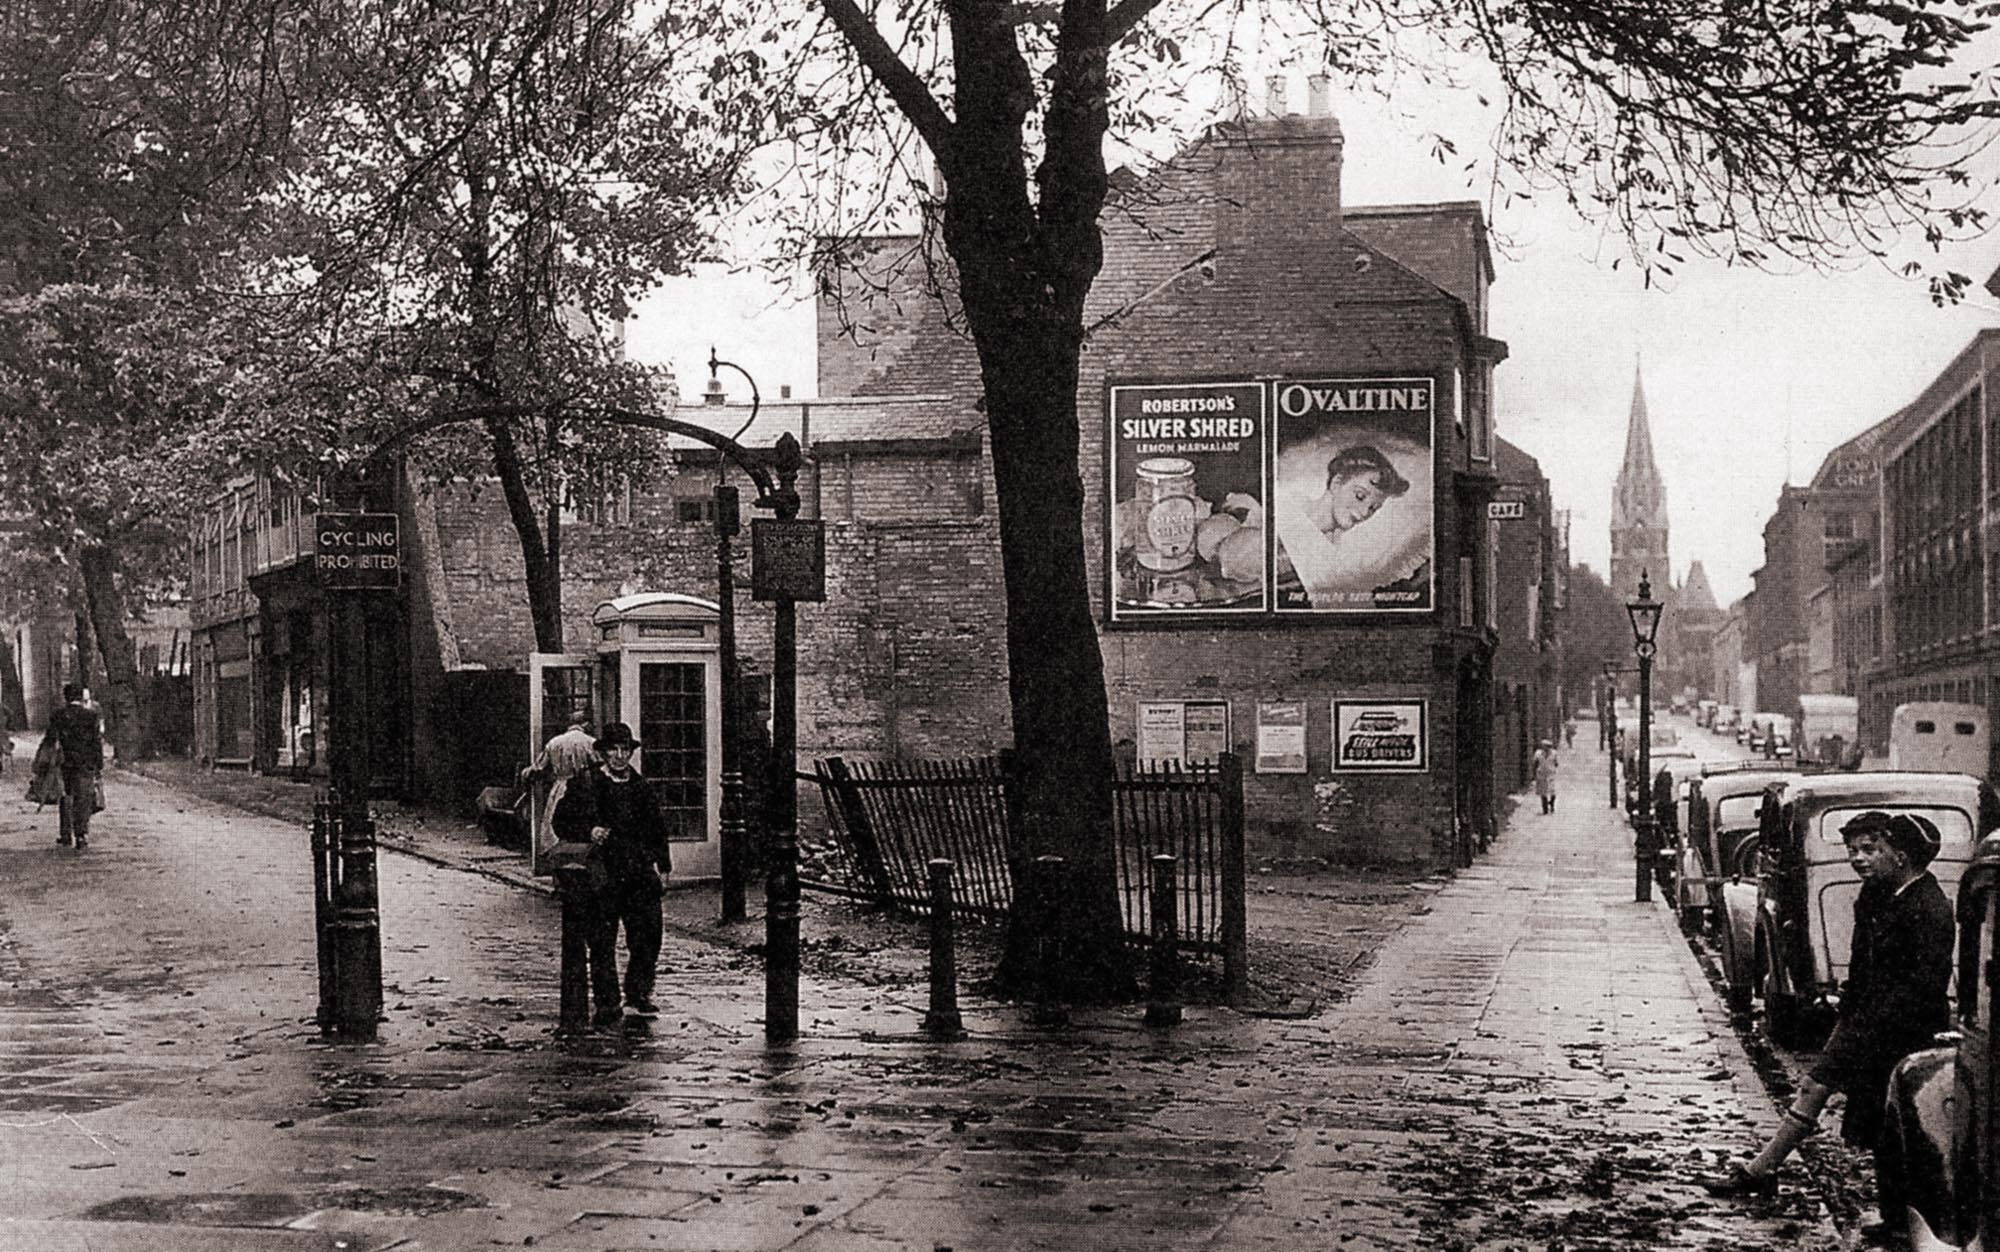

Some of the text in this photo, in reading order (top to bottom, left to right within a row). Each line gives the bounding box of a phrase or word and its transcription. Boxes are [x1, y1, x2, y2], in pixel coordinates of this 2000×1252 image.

[1142, 395, 1235, 413] ROBERTSON'S
[1280, 384, 1428, 417] OVALTINE
[1122, 417, 1255, 439] SILVER SHRED
[1136, 442, 1240, 453] LEMON MARMALADE
[320, 531, 395, 547] CYCLING
[319, 555, 398, 569] PROIBITED
